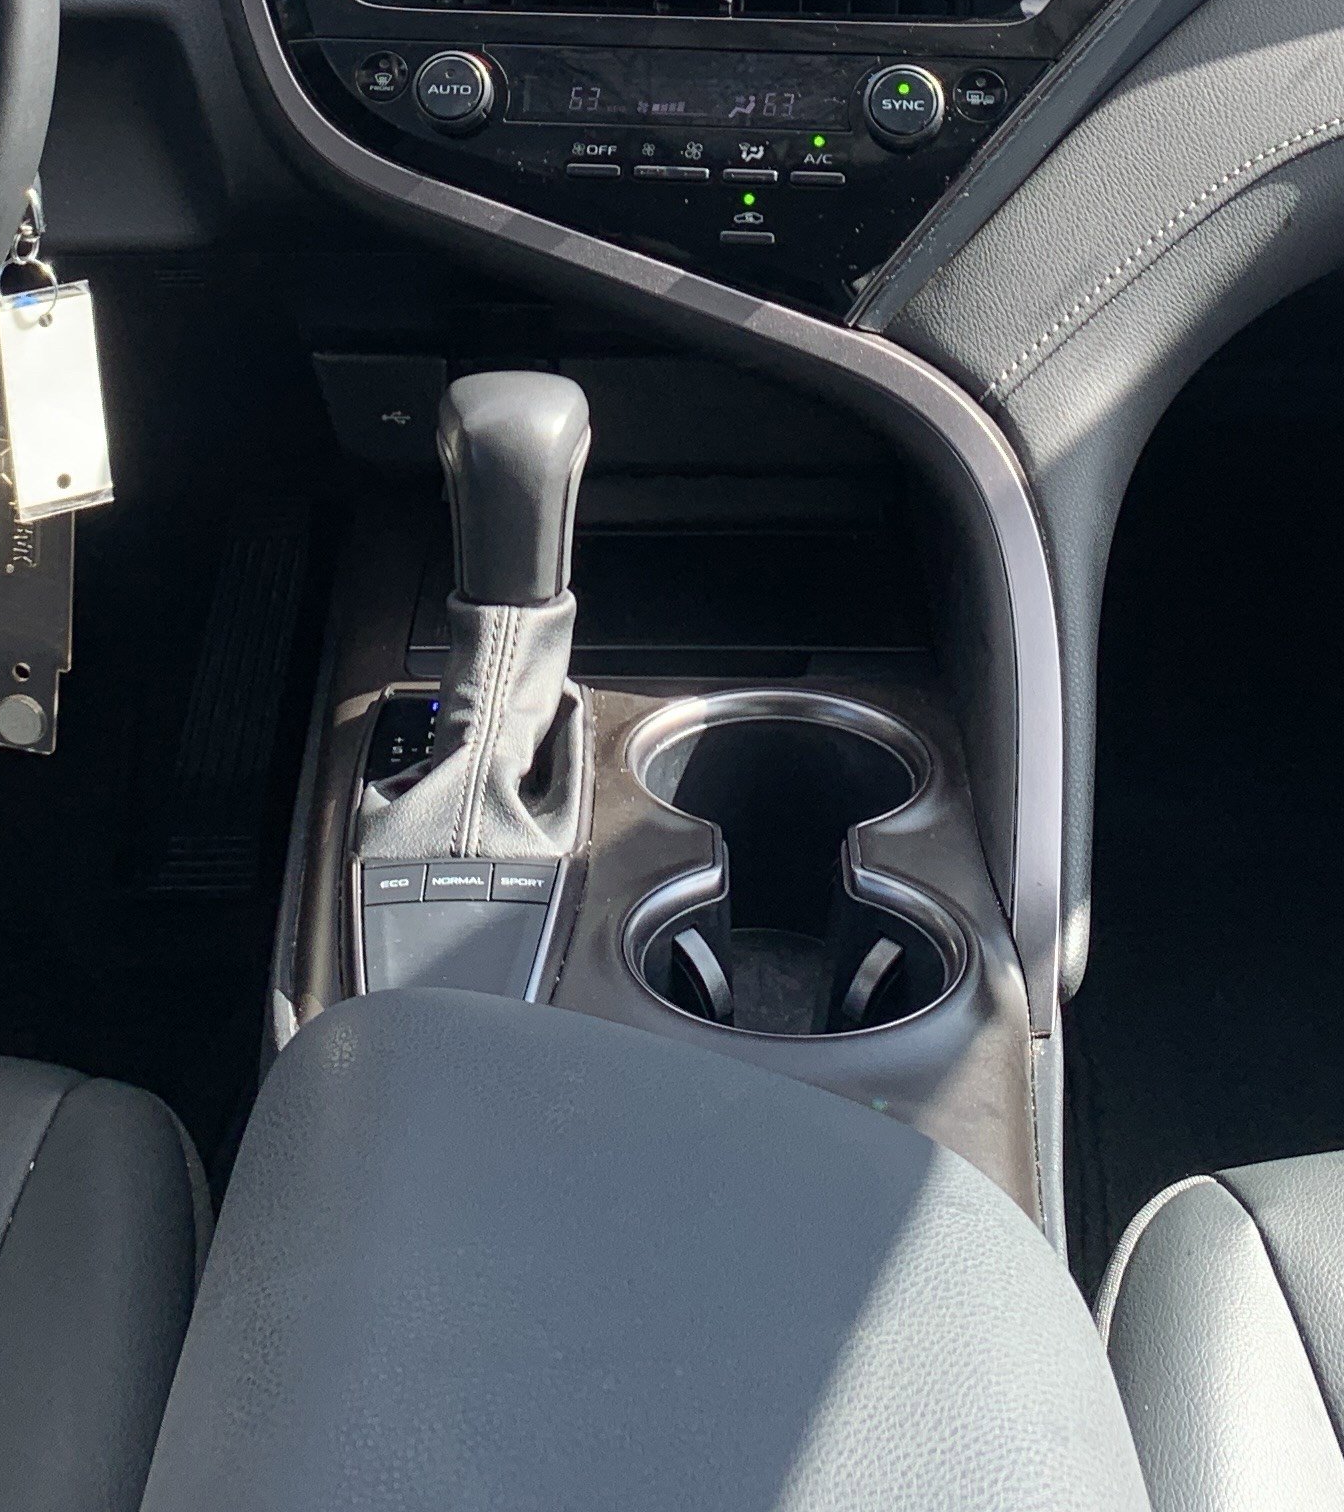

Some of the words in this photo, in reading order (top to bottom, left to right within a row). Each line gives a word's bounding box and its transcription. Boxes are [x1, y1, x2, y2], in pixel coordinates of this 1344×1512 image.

[427, 84, 472, 95] AUTO
[568, 87, 601, 111] 63
[762, 92, 795, 117] 63
[881, 98, 926, 112] SYNC
[586, 144, 618, 156] OFF
[803, 152, 834, 165] A/C
[380, 879, 410, 888] ECO
[432, 876, 485, 886] NORMAL
[500, 877, 545, 887] SPORT
